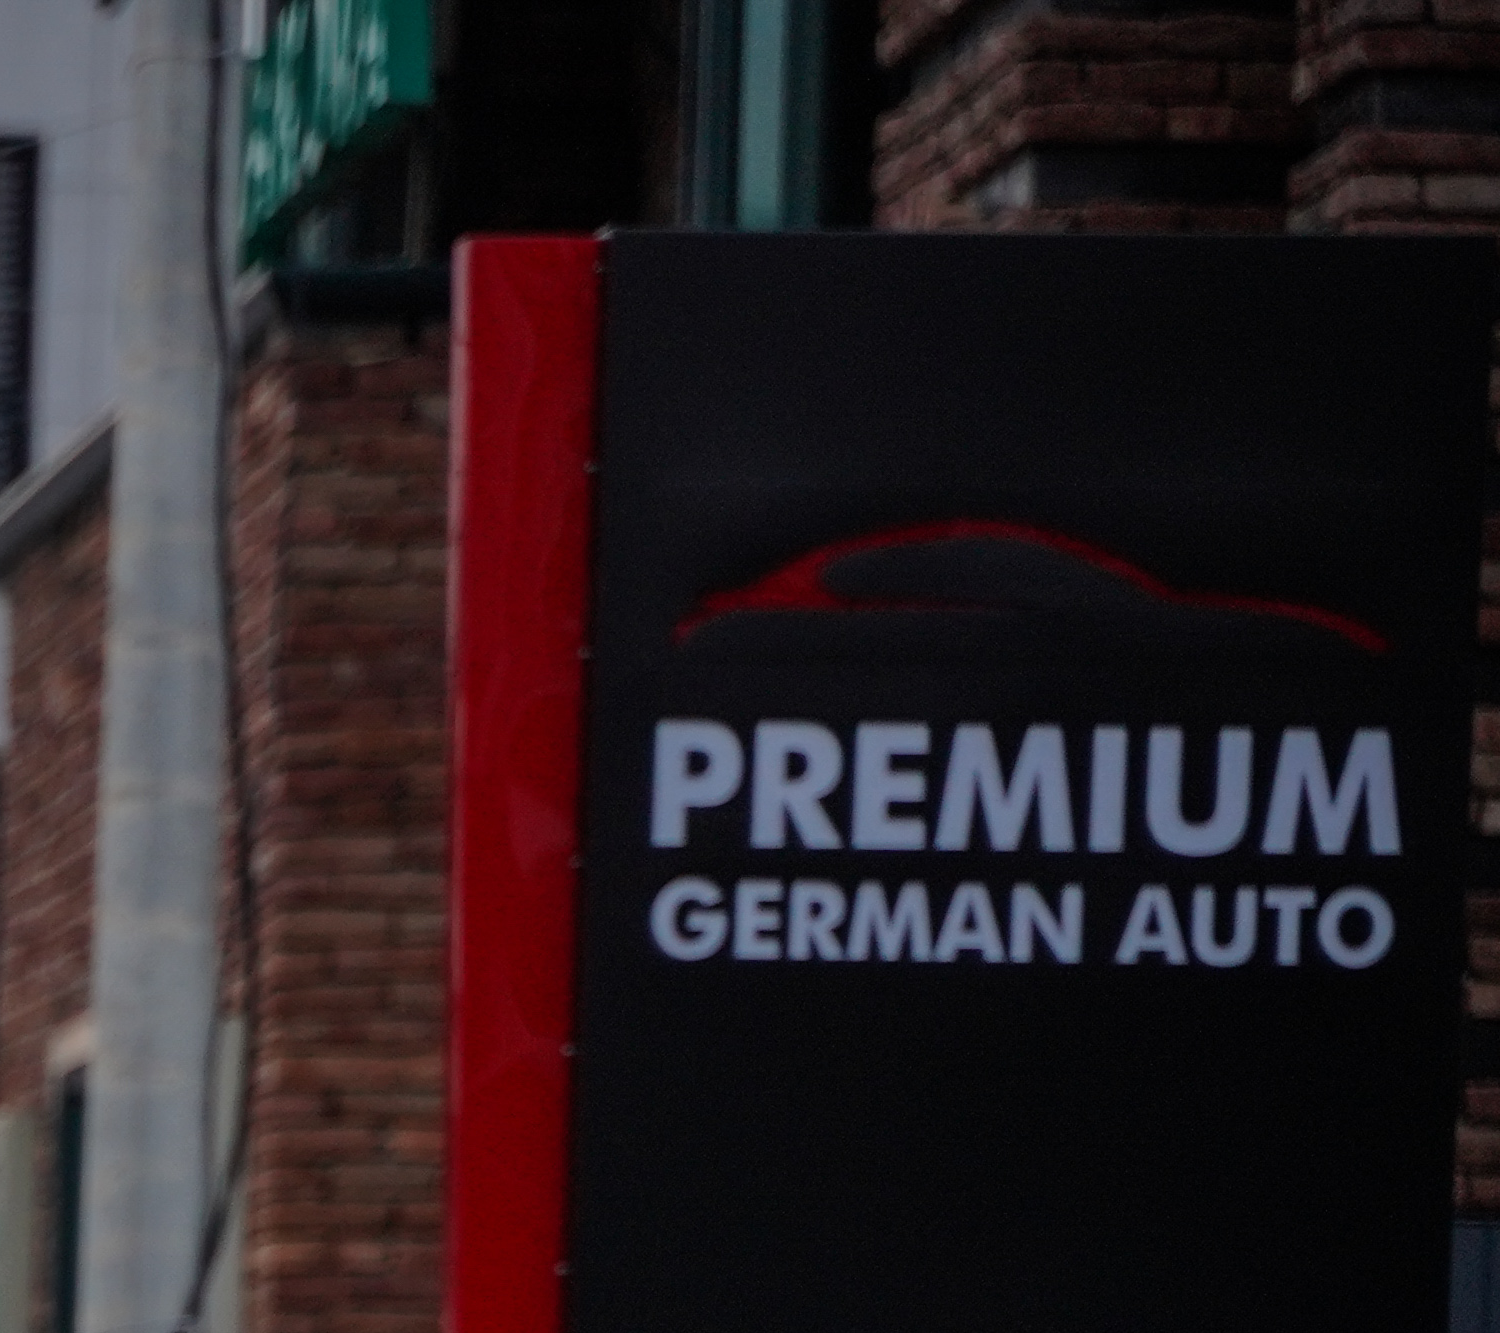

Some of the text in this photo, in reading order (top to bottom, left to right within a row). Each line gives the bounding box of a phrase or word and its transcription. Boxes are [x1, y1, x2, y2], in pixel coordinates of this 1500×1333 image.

[649, 717, 1402, 858] PREMIUM
[649, 875, 1396, 970] GERMAN AUTO
